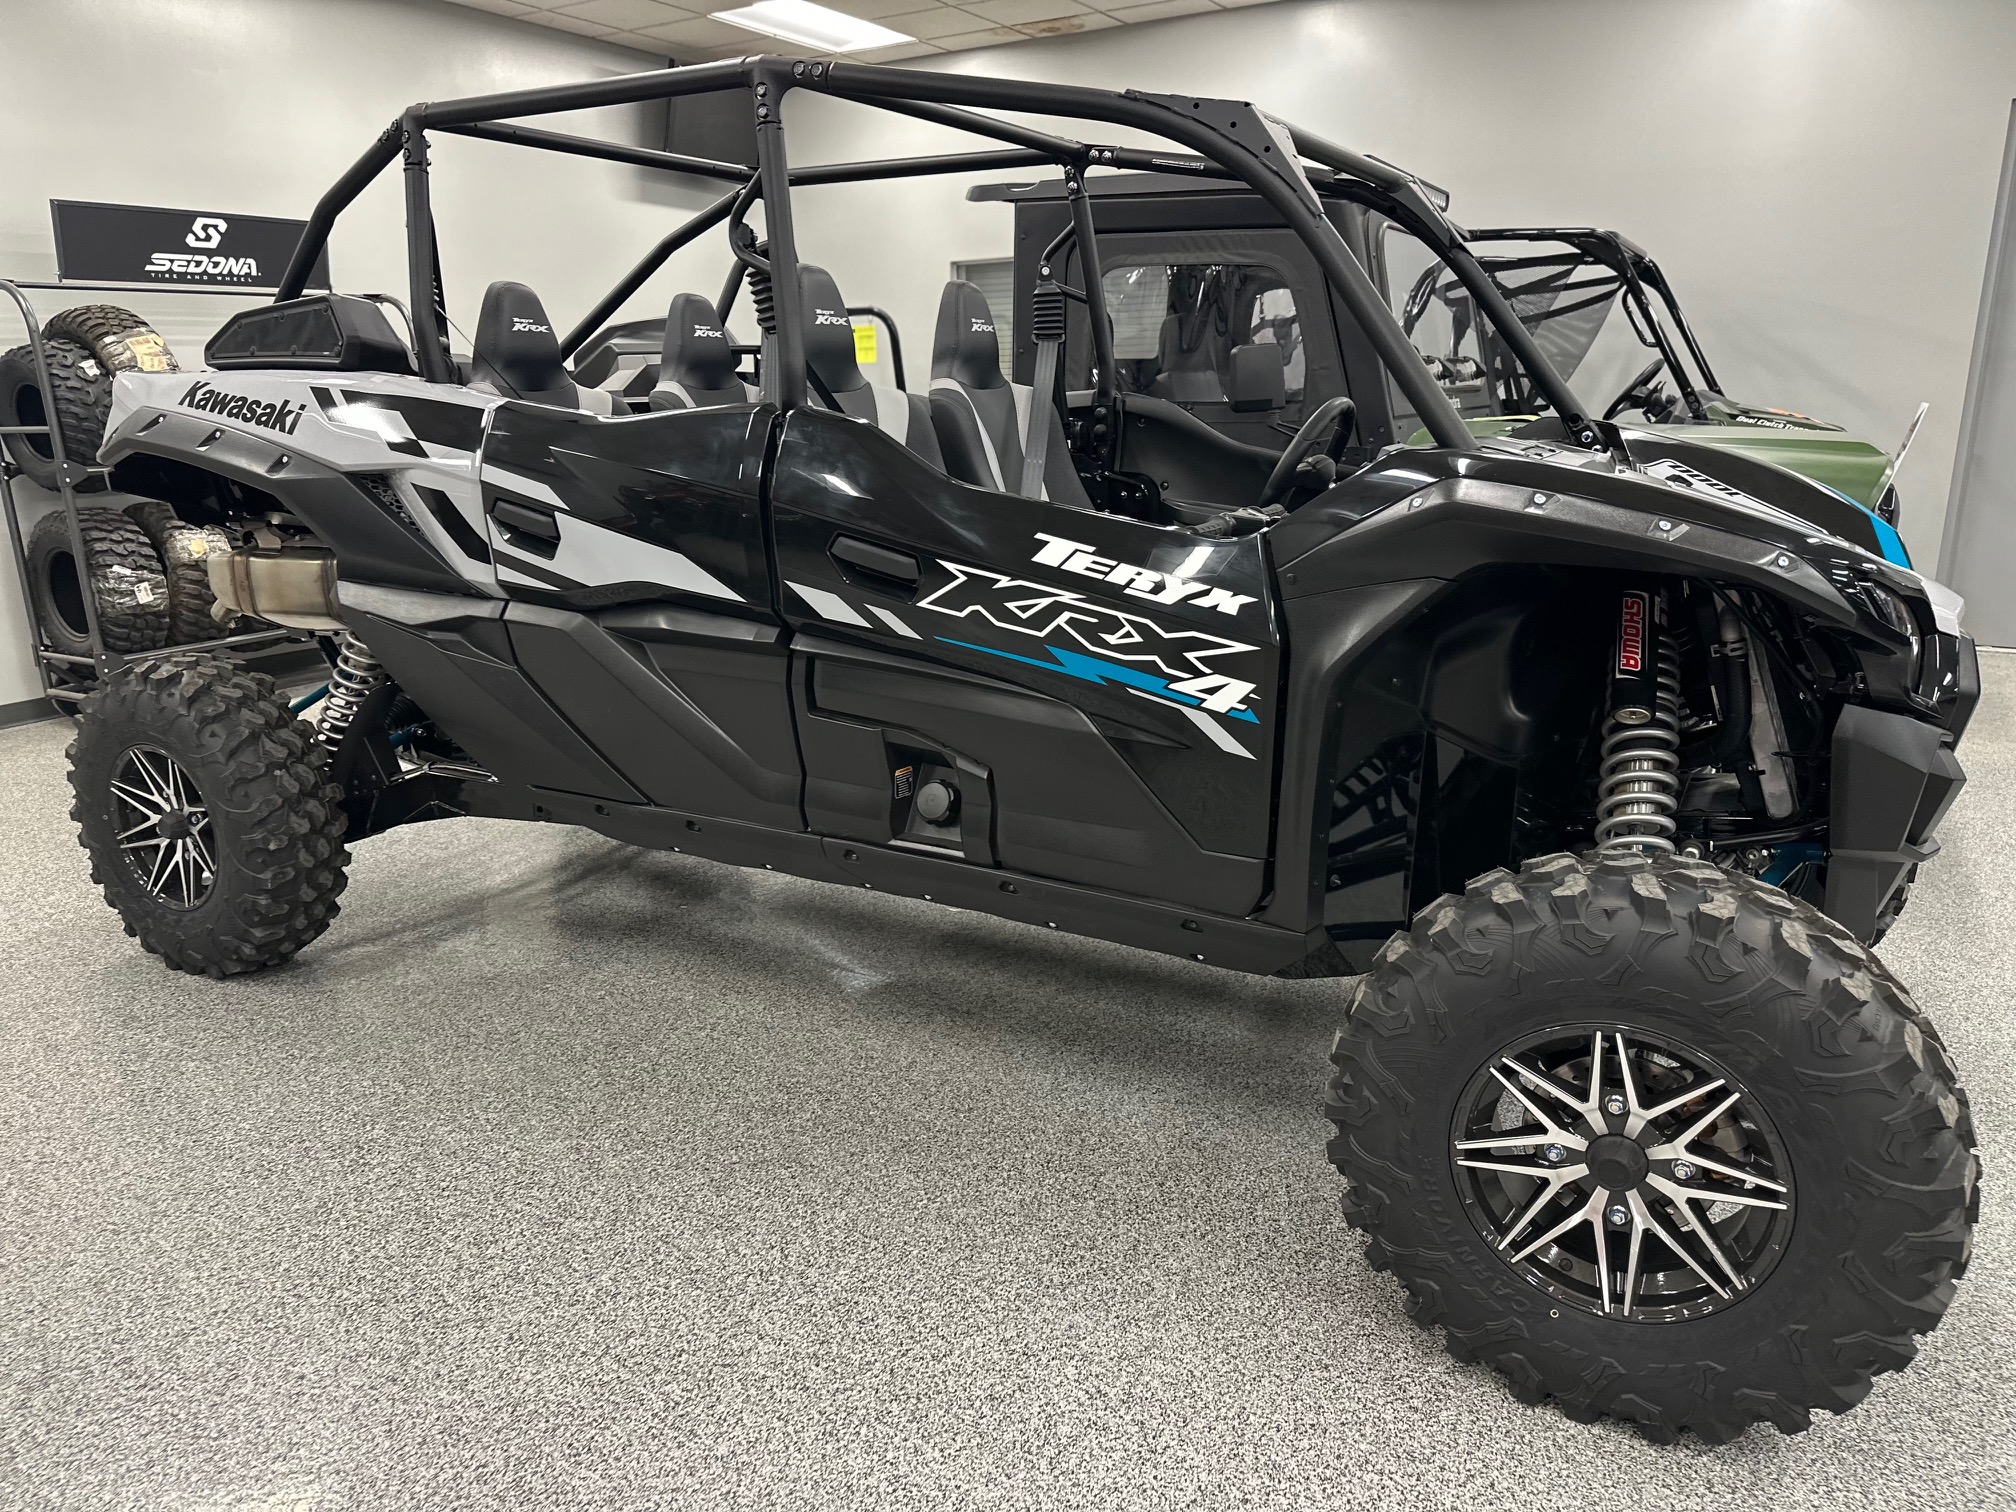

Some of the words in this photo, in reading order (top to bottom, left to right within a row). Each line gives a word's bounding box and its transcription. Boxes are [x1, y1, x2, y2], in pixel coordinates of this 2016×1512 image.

[144, 252, 257, 276] SEDONA
[814, 315, 849, 325] KRX
[512, 323, 550, 332] KRX
[693, 329, 724, 338] KRX
[971, 324, 995, 332] KRX
[178, 381, 307, 435] Kawasaki
[1735, 415, 1757, 424] Dual
[1756, 419, 1786, 429] Clutch
[915, 558, 1263, 679] KRX
[1167, 673, 1259, 714] 4
[1620, 598, 1642, 671] SHOWA
